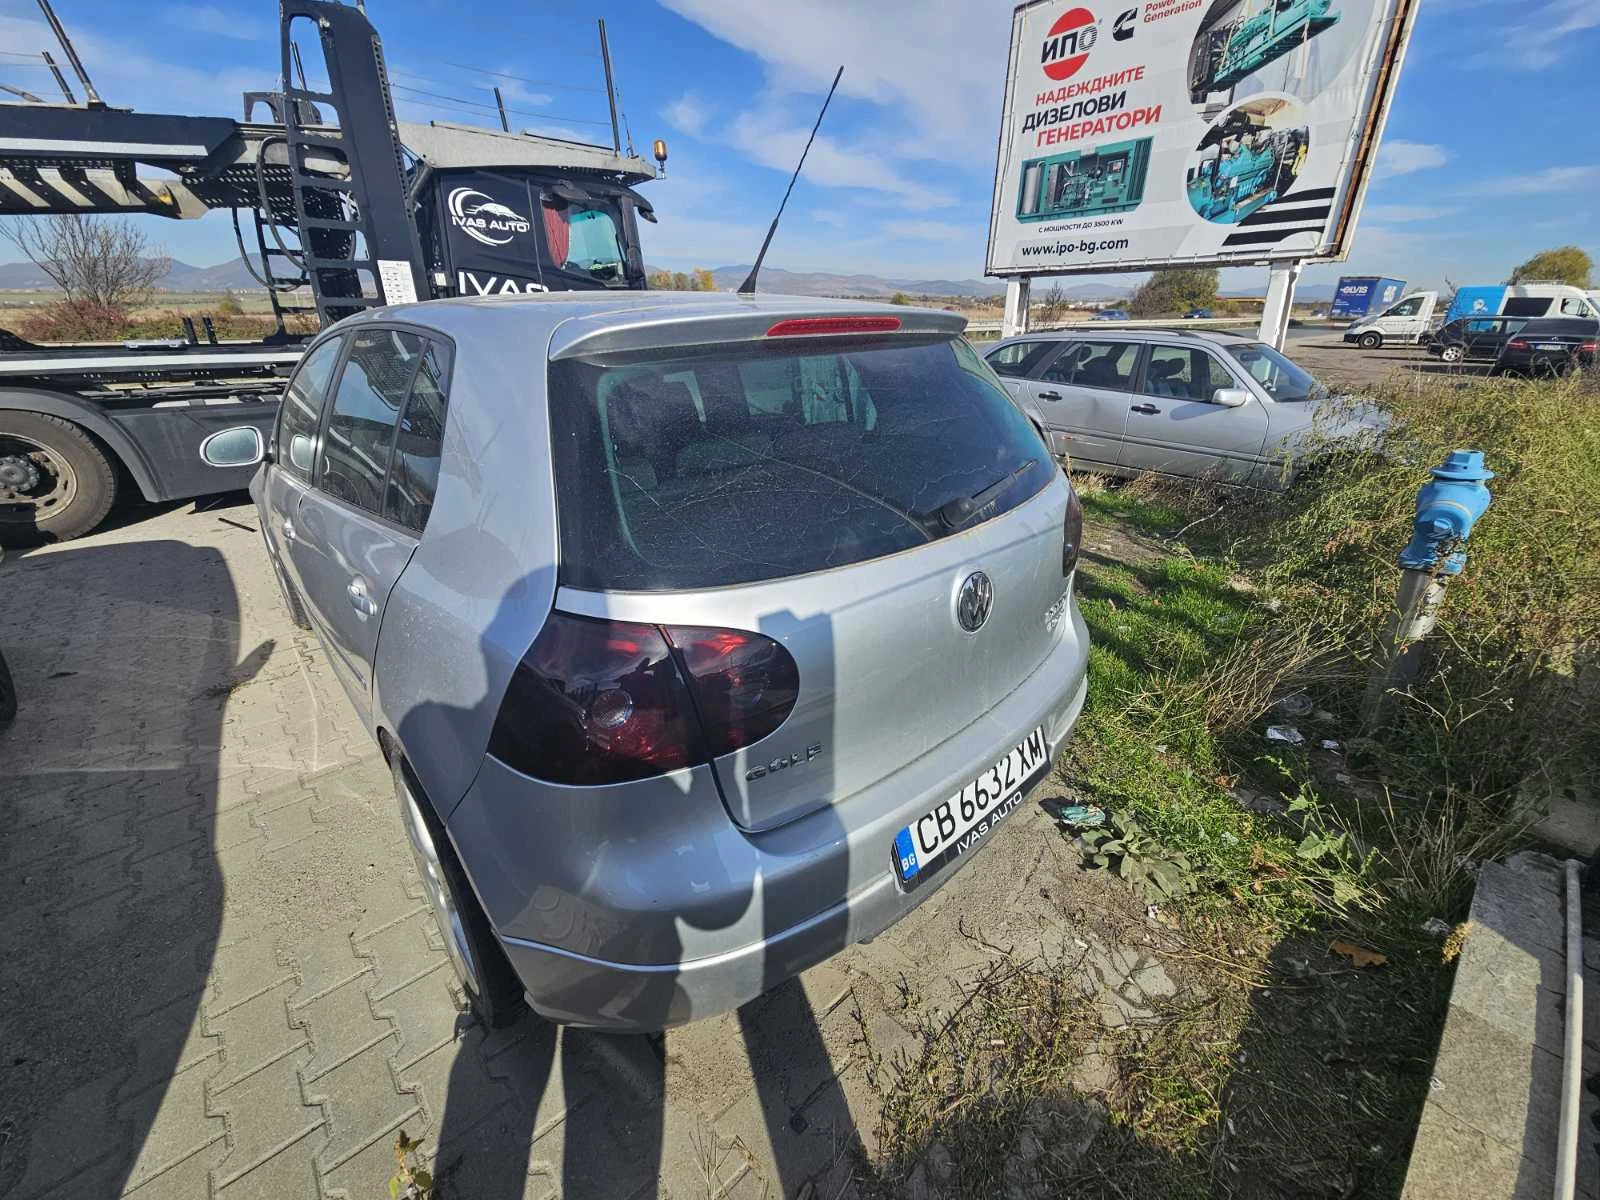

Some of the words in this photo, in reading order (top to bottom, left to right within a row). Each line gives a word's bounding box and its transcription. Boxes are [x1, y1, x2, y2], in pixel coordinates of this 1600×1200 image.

[1144, 0, 1203, 23] Generation
[1145, 0, 1177, 13] Power
[1041, 26, 1098, 64] ИПО
[1035, 66, 1145, 106] НАДЕЖДНИТЕ
[1022, 91, 1127, 133] ДИЗЕЛОВИ
[1036, 105, 1162, 147] ГЕНЕРАТОРИ
[452, 215, 486, 228] IVAS
[488, 220, 528, 233] AUTO
[1043, 223, 1081, 233] МОЩНОСТИ
[1081, 222, 1092, 230] ДО
[1022, 238, 1129, 256] www.ipo-bg.com
[745, 744, 822, 782] GOLF
[917, 802, 956, 855] CB
[960, 756, 1016, 823] 6632
[1017, 729, 1043, 777] XM
[956, 822, 989, 855] IVAS
[991, 791, 1023, 822] AUTO
[901, 853, 916, 872] BG
